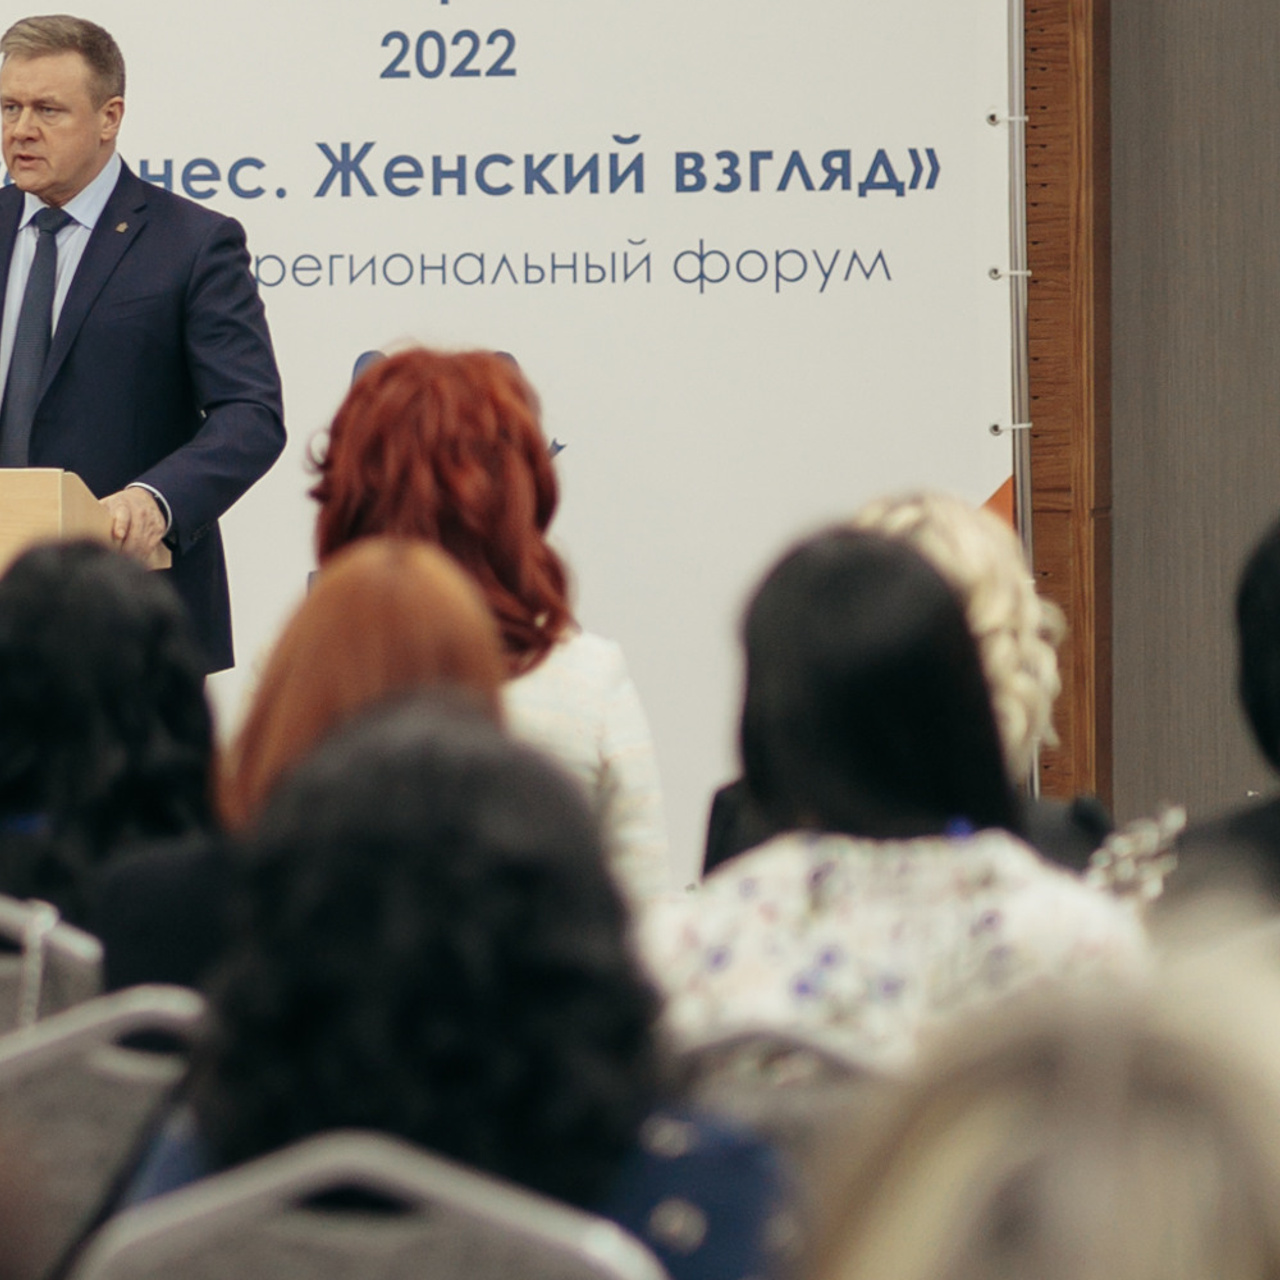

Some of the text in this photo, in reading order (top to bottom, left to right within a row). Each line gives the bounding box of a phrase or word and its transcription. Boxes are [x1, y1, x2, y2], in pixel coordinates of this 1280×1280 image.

[379, 29, 517, 80] 2022
[314, 135, 646, 199] Женский
[675, 147, 942, 199] взгляд»
[255, 239, 893, 293] региональный форум
